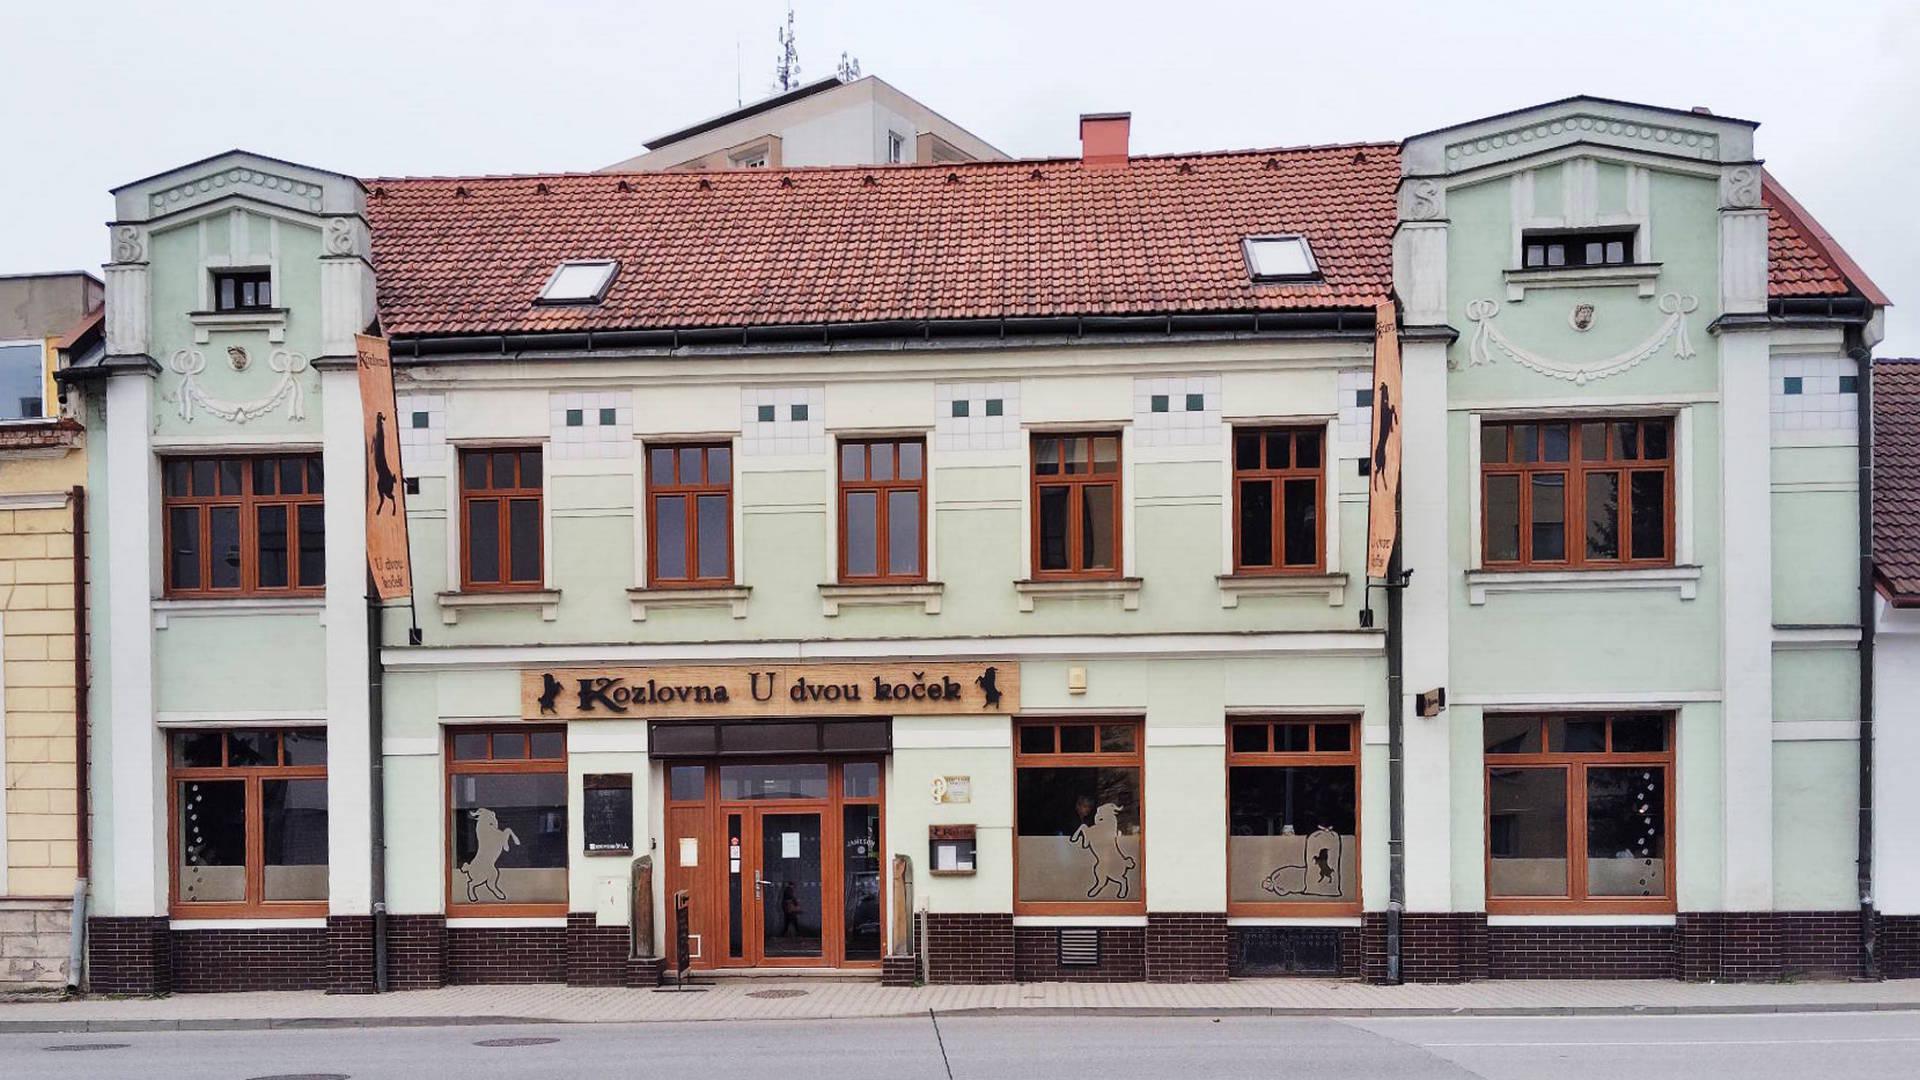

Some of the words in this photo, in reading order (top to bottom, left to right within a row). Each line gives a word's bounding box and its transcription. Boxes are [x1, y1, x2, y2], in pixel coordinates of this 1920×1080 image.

[576, 677, 729, 713] Kozlovna
[748, 672, 776, 701] U
[789, 677, 861, 702] dvou
[872, 671, 962, 701] koček
